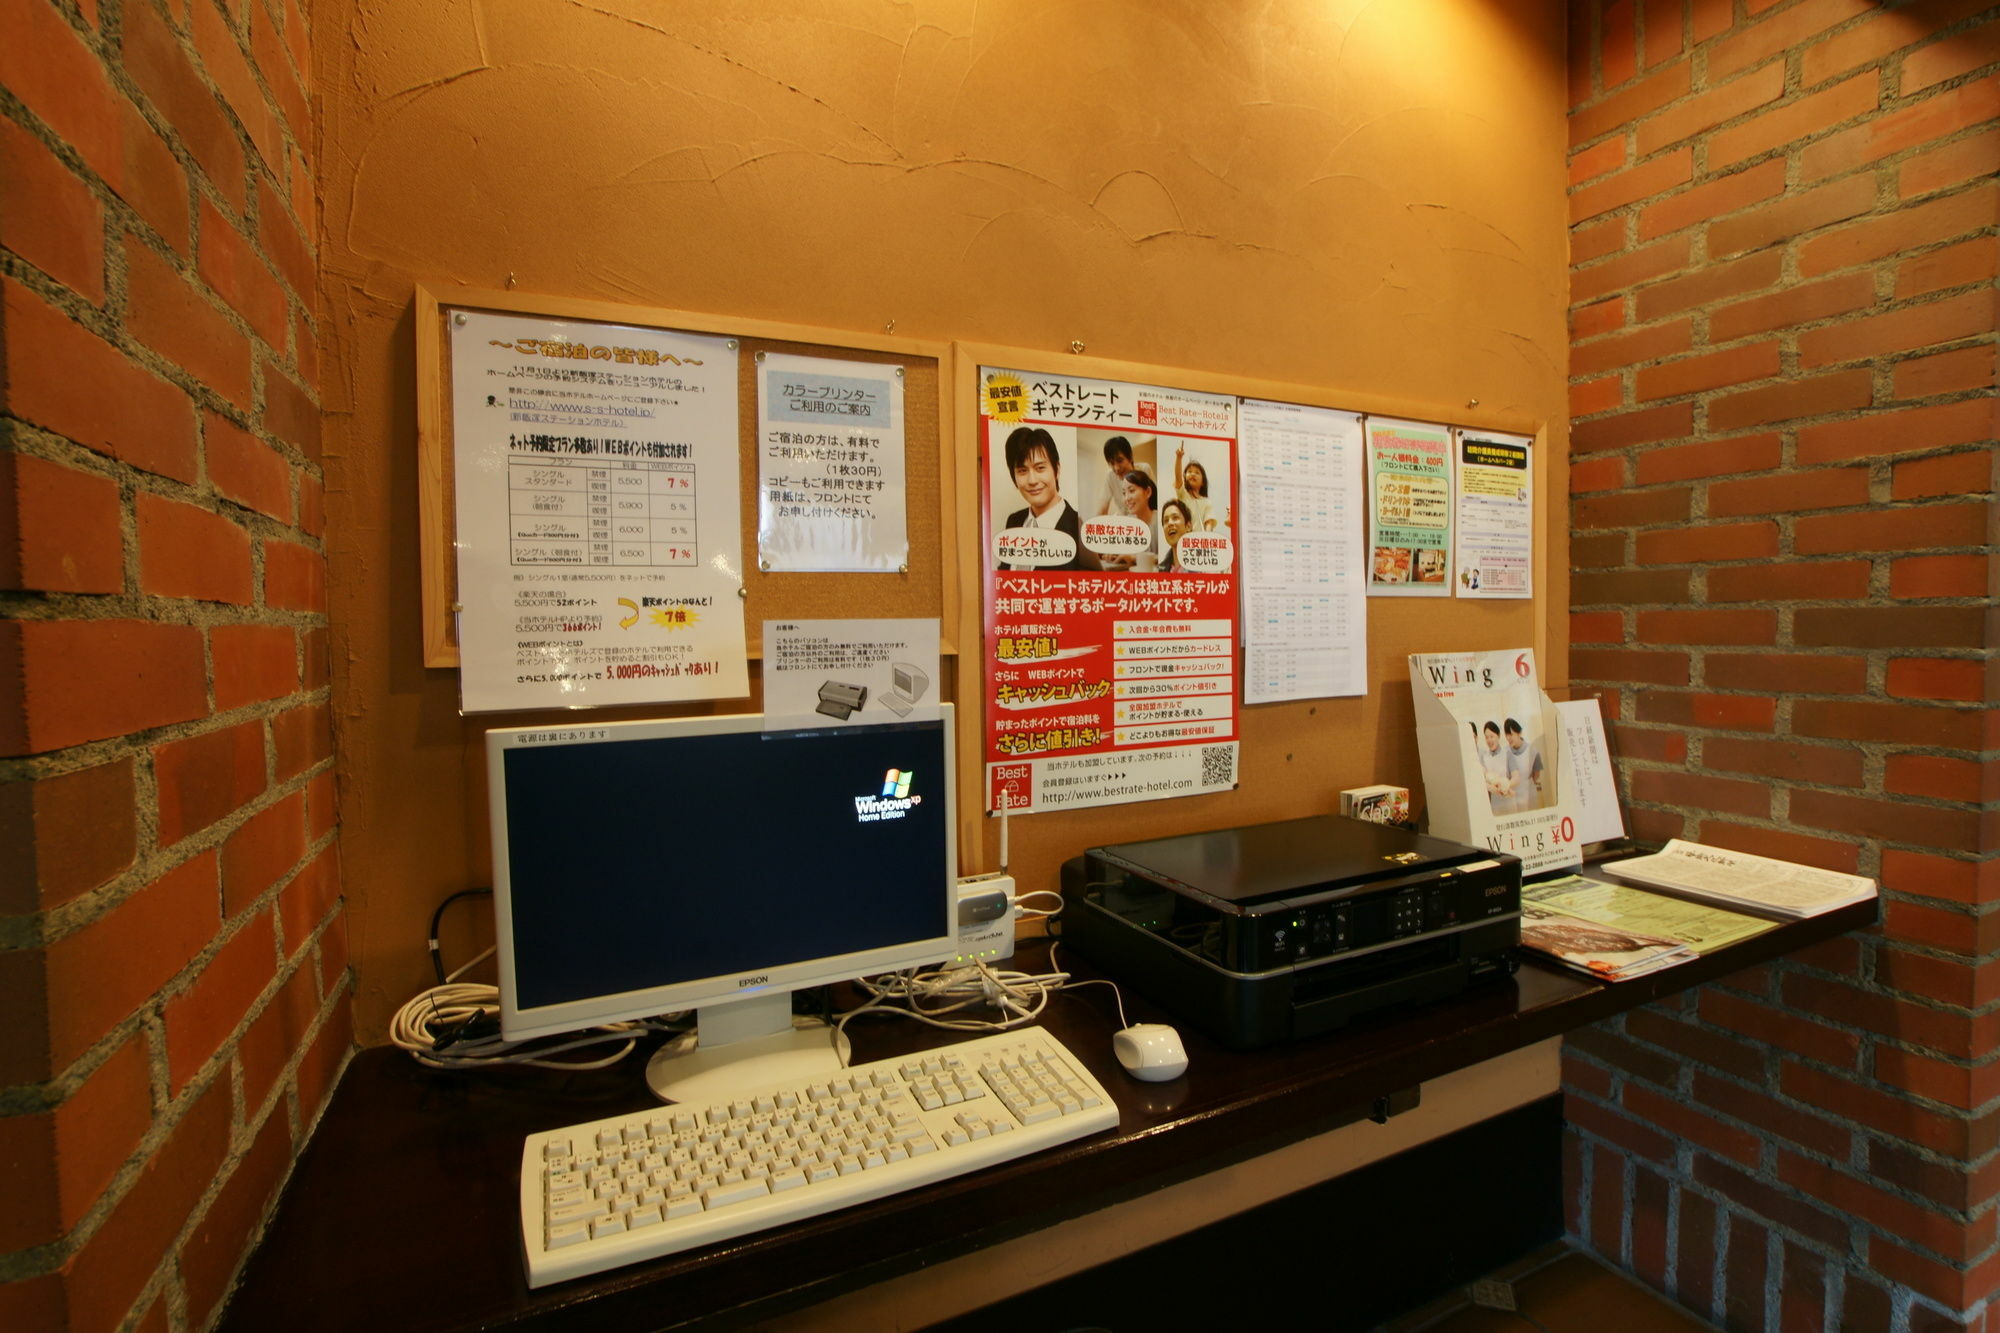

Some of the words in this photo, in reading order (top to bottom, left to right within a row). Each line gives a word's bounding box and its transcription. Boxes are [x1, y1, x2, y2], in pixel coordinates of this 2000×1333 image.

[989, 384, 1023, 400] 最安値
[1032, 380, 1120, 405] ベストレート
[790, 400, 871, 416] ご利用のご案内
[997, 400, 1020, 413] 宣言
[1032, 400, 1133, 424] ギャランティー
[768, 431, 880, 448] ご宿泊の方は、有料で
[768, 447, 875, 463] ご利用いただけます。
[768, 476, 886, 491] コピーもご利用できます
[769, 490, 872, 505] 用紙は、フロントにて
[778, 505, 877, 520] お申し付けください。
[1085, 523, 1145, 536] 素敵なホテル
[999, 536, 1048, 548] ポイントが
[1085, 535, 1148, 546] がいっぱいあるね
[1182, 538, 1227, 549] 最安値保証
[999, 547, 1073, 558] 貯まってうれしいね
[1182, 556, 1219, 566] やさしいね
[995, 578, 1230, 595] 『ベストレートホテルズ』は独立系ホテルが
[995, 596, 1200, 615] 共同で運営するポータルサイトです。
[994, 624, 1064, 635] ホテル直販だから
[1128, 624, 1192, 634] 入会金・年会費も無料
[1128, 645, 1222, 655] WEBポイントだからカードレス
[1515, 653, 1531, 678] 6
[994, 670, 1020, 681] さらに
[1027, 668, 1085, 680] WEBポイントで
[1429, 665, 1494, 688] Wing
[996, 680, 1112, 705] キャッシュバック
[1128, 681, 1218, 693] 次回から30%ポイント値引き
[1128, 700, 1183, 711] 全国加盟ホテルで
[1128, 708, 1204, 721] ポイントが貯まる・使える
[995, 714, 1101, 731] 貯まったポイントで宿泊料を
[517, 730, 608, 744] 電源は裏にあります
[1128, 726, 1215, 741] どこよりもお得な最安値保証
[996, 765, 1029, 780] Best
[1042, 774, 1107, 788] 会員登録はいますぐ
[1042, 778, 1194, 804] http://www.bestrate-hotel.com
[855, 798, 912, 815] Windows
[858, 813, 880, 823] Home
[881, 810, 906, 820] Edition
[1486, 832, 1545, 852] Wing
[1485, 885, 1507, 897] EPSON
[738, 975, 769, 988] EPSON
